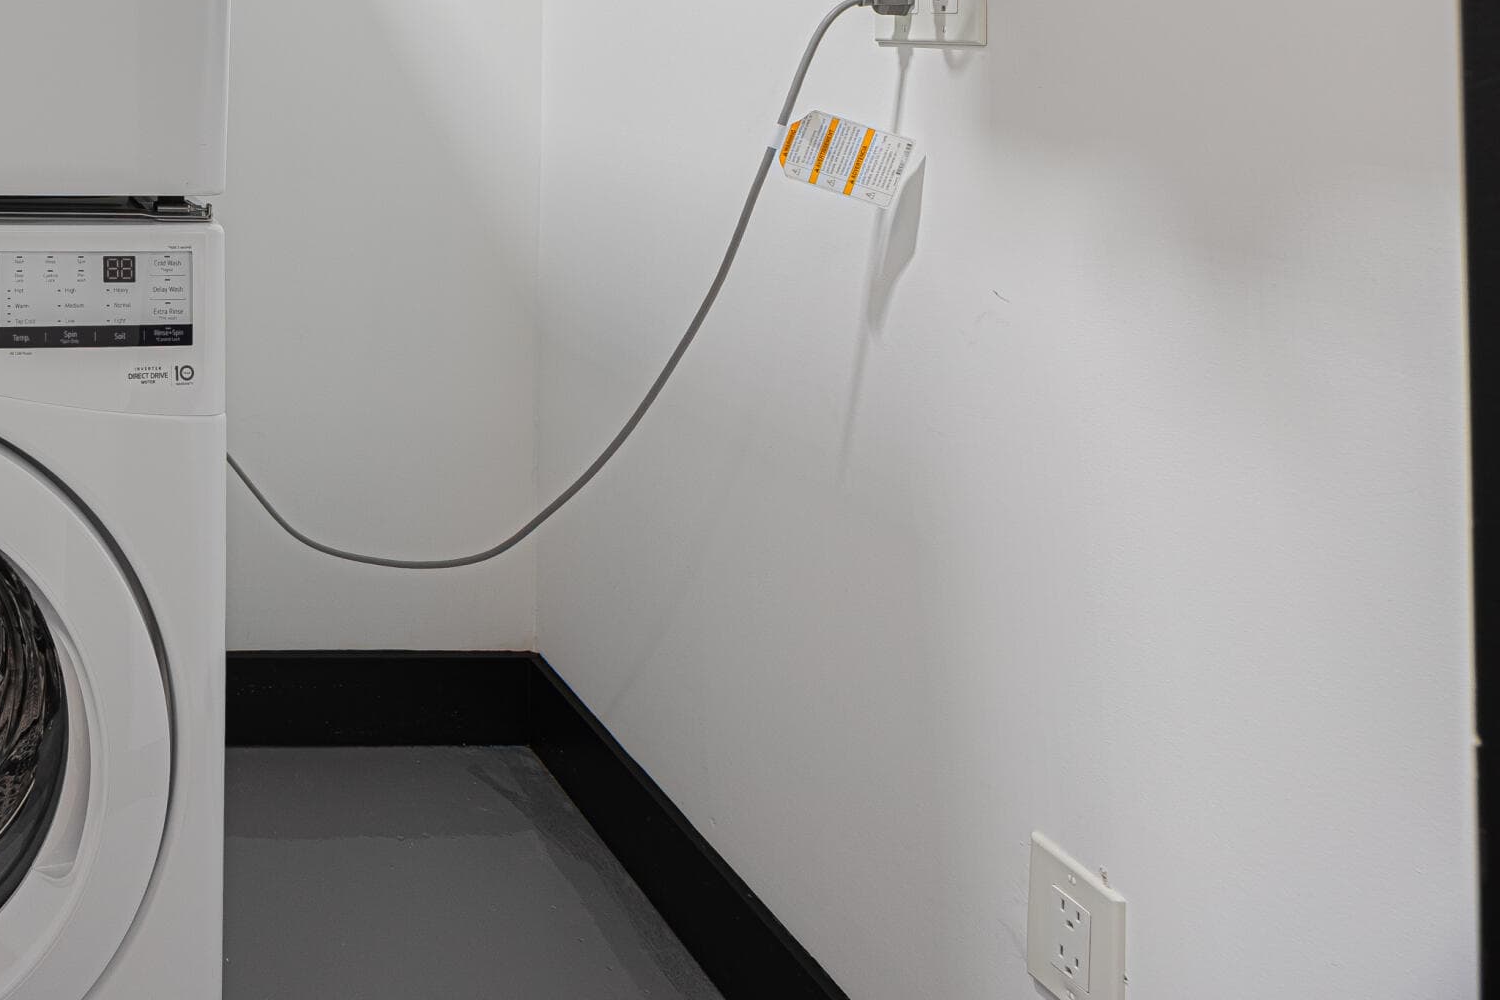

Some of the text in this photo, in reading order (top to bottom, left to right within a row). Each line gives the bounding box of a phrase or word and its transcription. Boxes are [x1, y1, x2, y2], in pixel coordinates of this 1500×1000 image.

[153, 286, 168, 294] Delay
[153, 308, 167, 316] Extra
[63, 330, 78, 340] Spin
[114, 331, 126, 340] Soil
[128, 371, 169, 380] DIRECT DRIVE
[174, 364, 195, 381] 10
